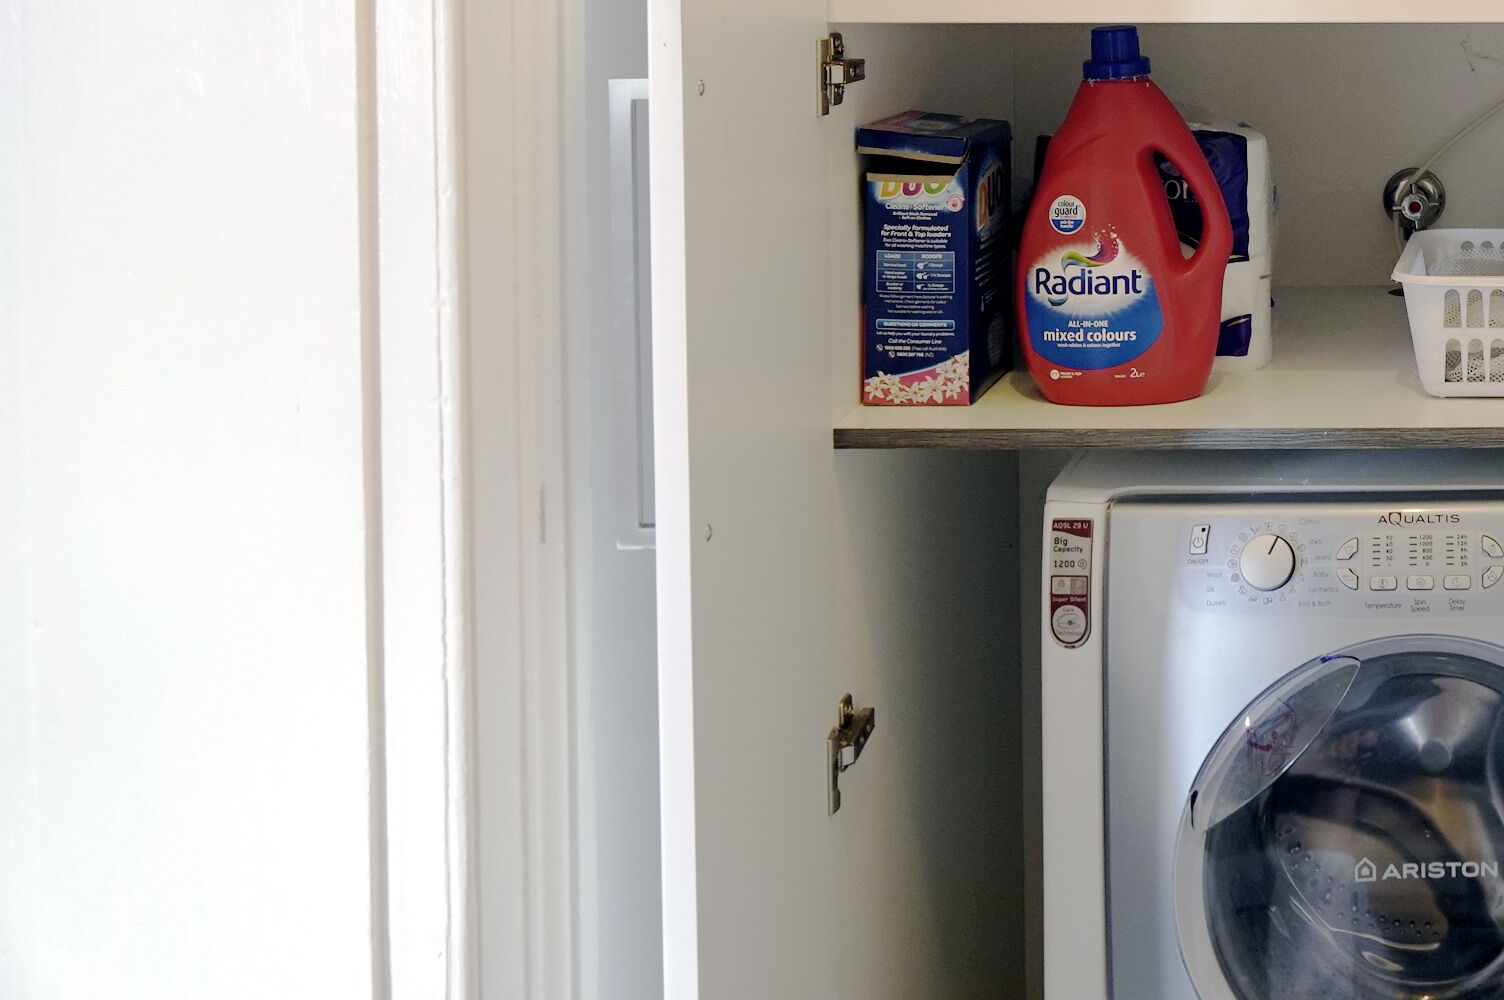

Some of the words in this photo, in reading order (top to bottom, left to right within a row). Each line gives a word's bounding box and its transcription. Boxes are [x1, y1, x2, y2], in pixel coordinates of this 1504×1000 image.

[1054, 205, 1078, 218] guard
[883, 223, 911, 232] Specially
[911, 224, 949, 232] formulated
[880, 229, 890, 237] for
[1035, 267, 1143, 296] Radiant
[1067, 320, 1109, 328] ALL-IN-ONE
[1043, 328, 1085, 342] mixed
[1086, 328, 1137, 342] colours
[1377, 511, 1461, 528] AQUALTIS
[1053, 537, 1068, 547] Big
[1053, 560, 1076, 568] 1200
[1364, 602, 1402, 610] Temperature
[1381, 861, 1498, 880] ARISTON
